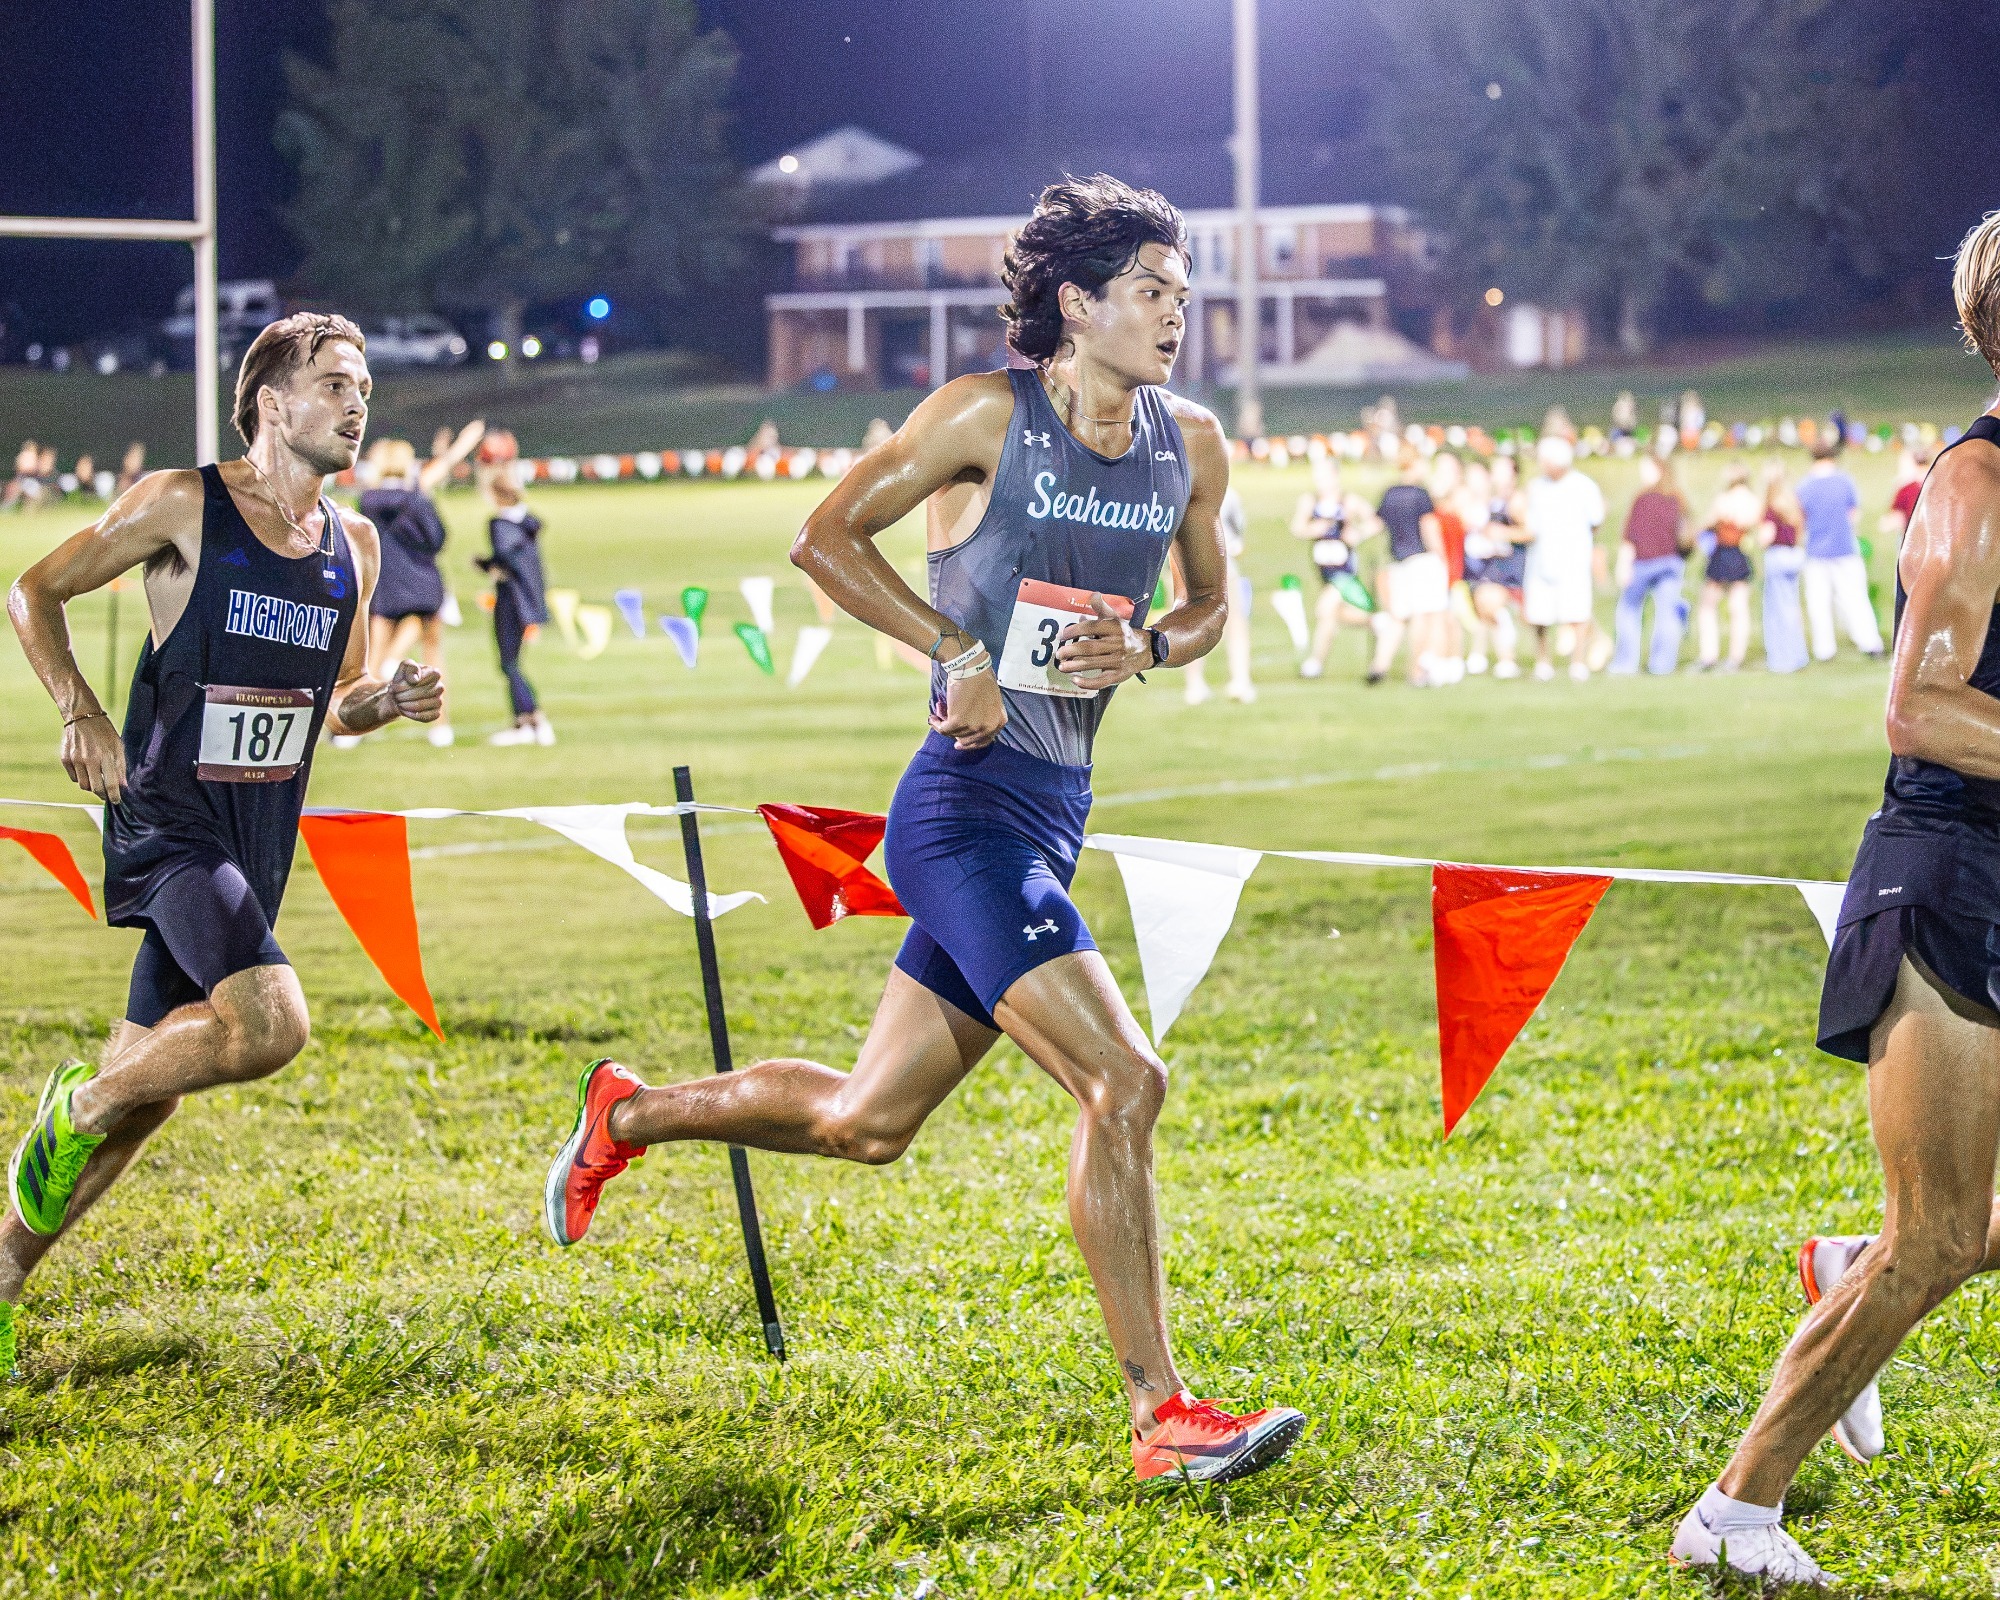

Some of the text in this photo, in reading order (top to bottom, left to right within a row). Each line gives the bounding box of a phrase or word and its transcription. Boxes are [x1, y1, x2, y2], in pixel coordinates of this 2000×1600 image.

[1154, 450, 1177, 462] CAA
[1027, 471, 1175, 534] Seahawks
[229, 712, 295, 762] 187
